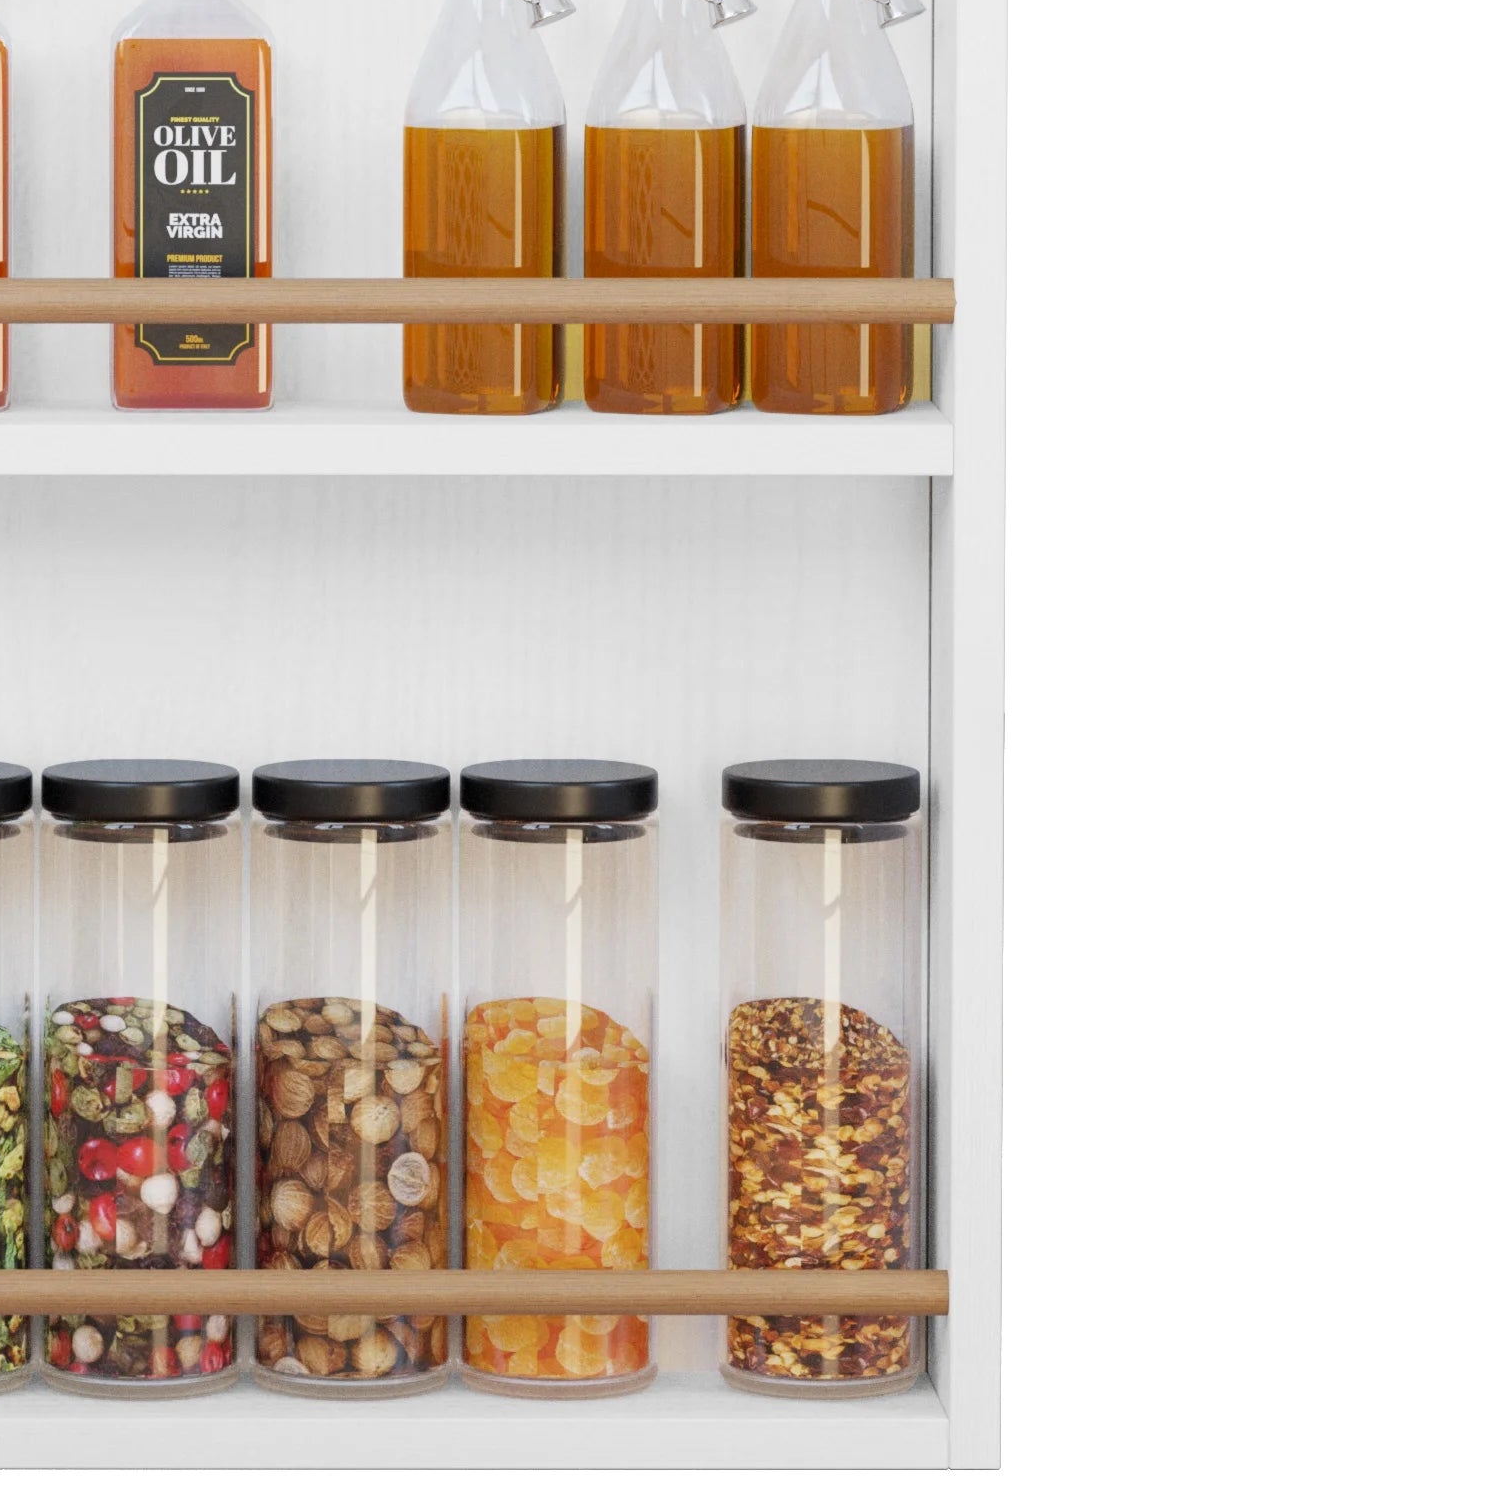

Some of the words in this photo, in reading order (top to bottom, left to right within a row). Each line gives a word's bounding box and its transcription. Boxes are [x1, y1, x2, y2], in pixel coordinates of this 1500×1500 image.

[154, 125, 236, 147] OLIVE
[154, 149, 236, 185] OIL
[170, 213, 221, 226] EXTRA
[166, 226, 224, 239] VIRGIN
[167, 254, 195, 263] PREMIUM
[196, 254, 224, 263] PRODUCT
